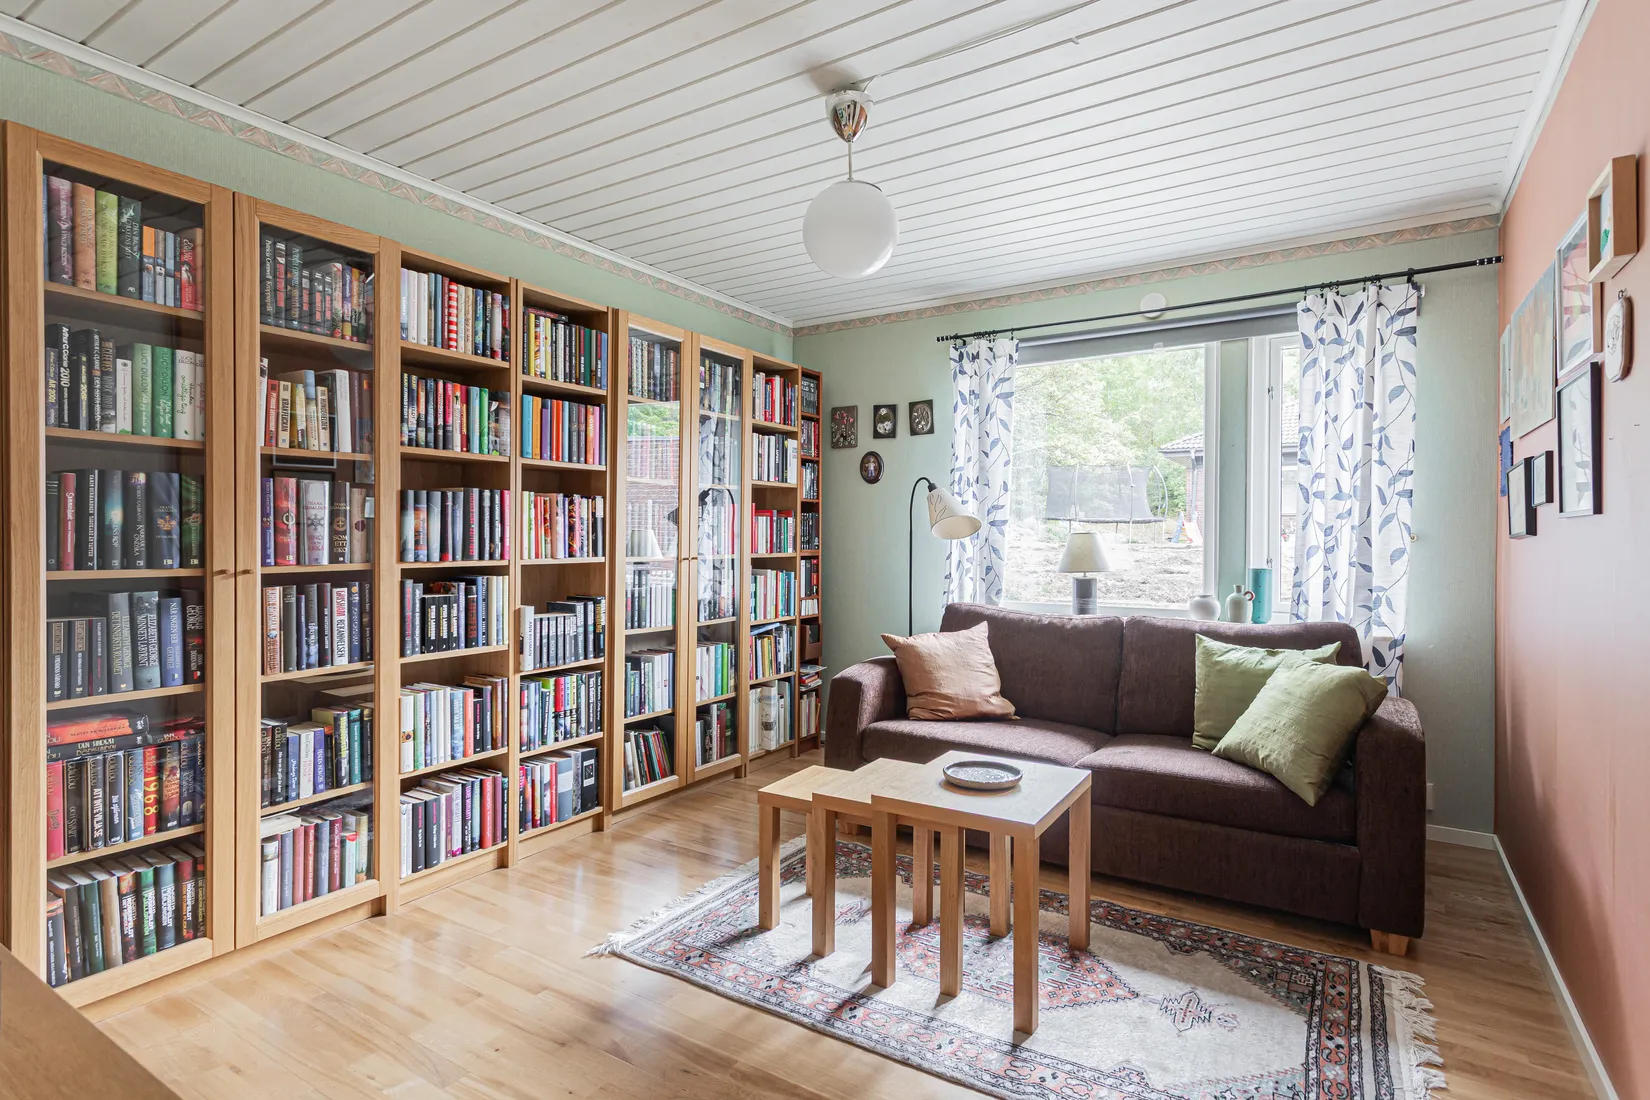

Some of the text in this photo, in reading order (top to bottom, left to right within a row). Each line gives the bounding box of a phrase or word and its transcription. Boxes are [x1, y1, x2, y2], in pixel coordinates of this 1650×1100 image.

[102, 348, 112, 372] CLEEVES
[60, 368, 70, 386] 2010
[336, 590, 346, 616] GRISHAM
[170, 602, 178, 644] NÄR INGEN SER
[186, 605, 198, 630] GEORGE
[112, 611, 122, 676] DET INNERSTA RUMMET
[122, 616, 131, 669] ELIZABETH GEORGE
[137, 616, 148, 666] MINNETS LABYRINT
[148, 614, 158, 666] ELIZABETH GEORGE
[166, 646, 174, 669] GEORGE
[68, 763, 76, 790] GUILLOU
[108, 757, 116, 782] GUILLOU
[144, 776, 159, 816] 1968
[94, 788, 102, 838] ATT INTE VILJA SE
[67, 819, 76, 838] SVART
